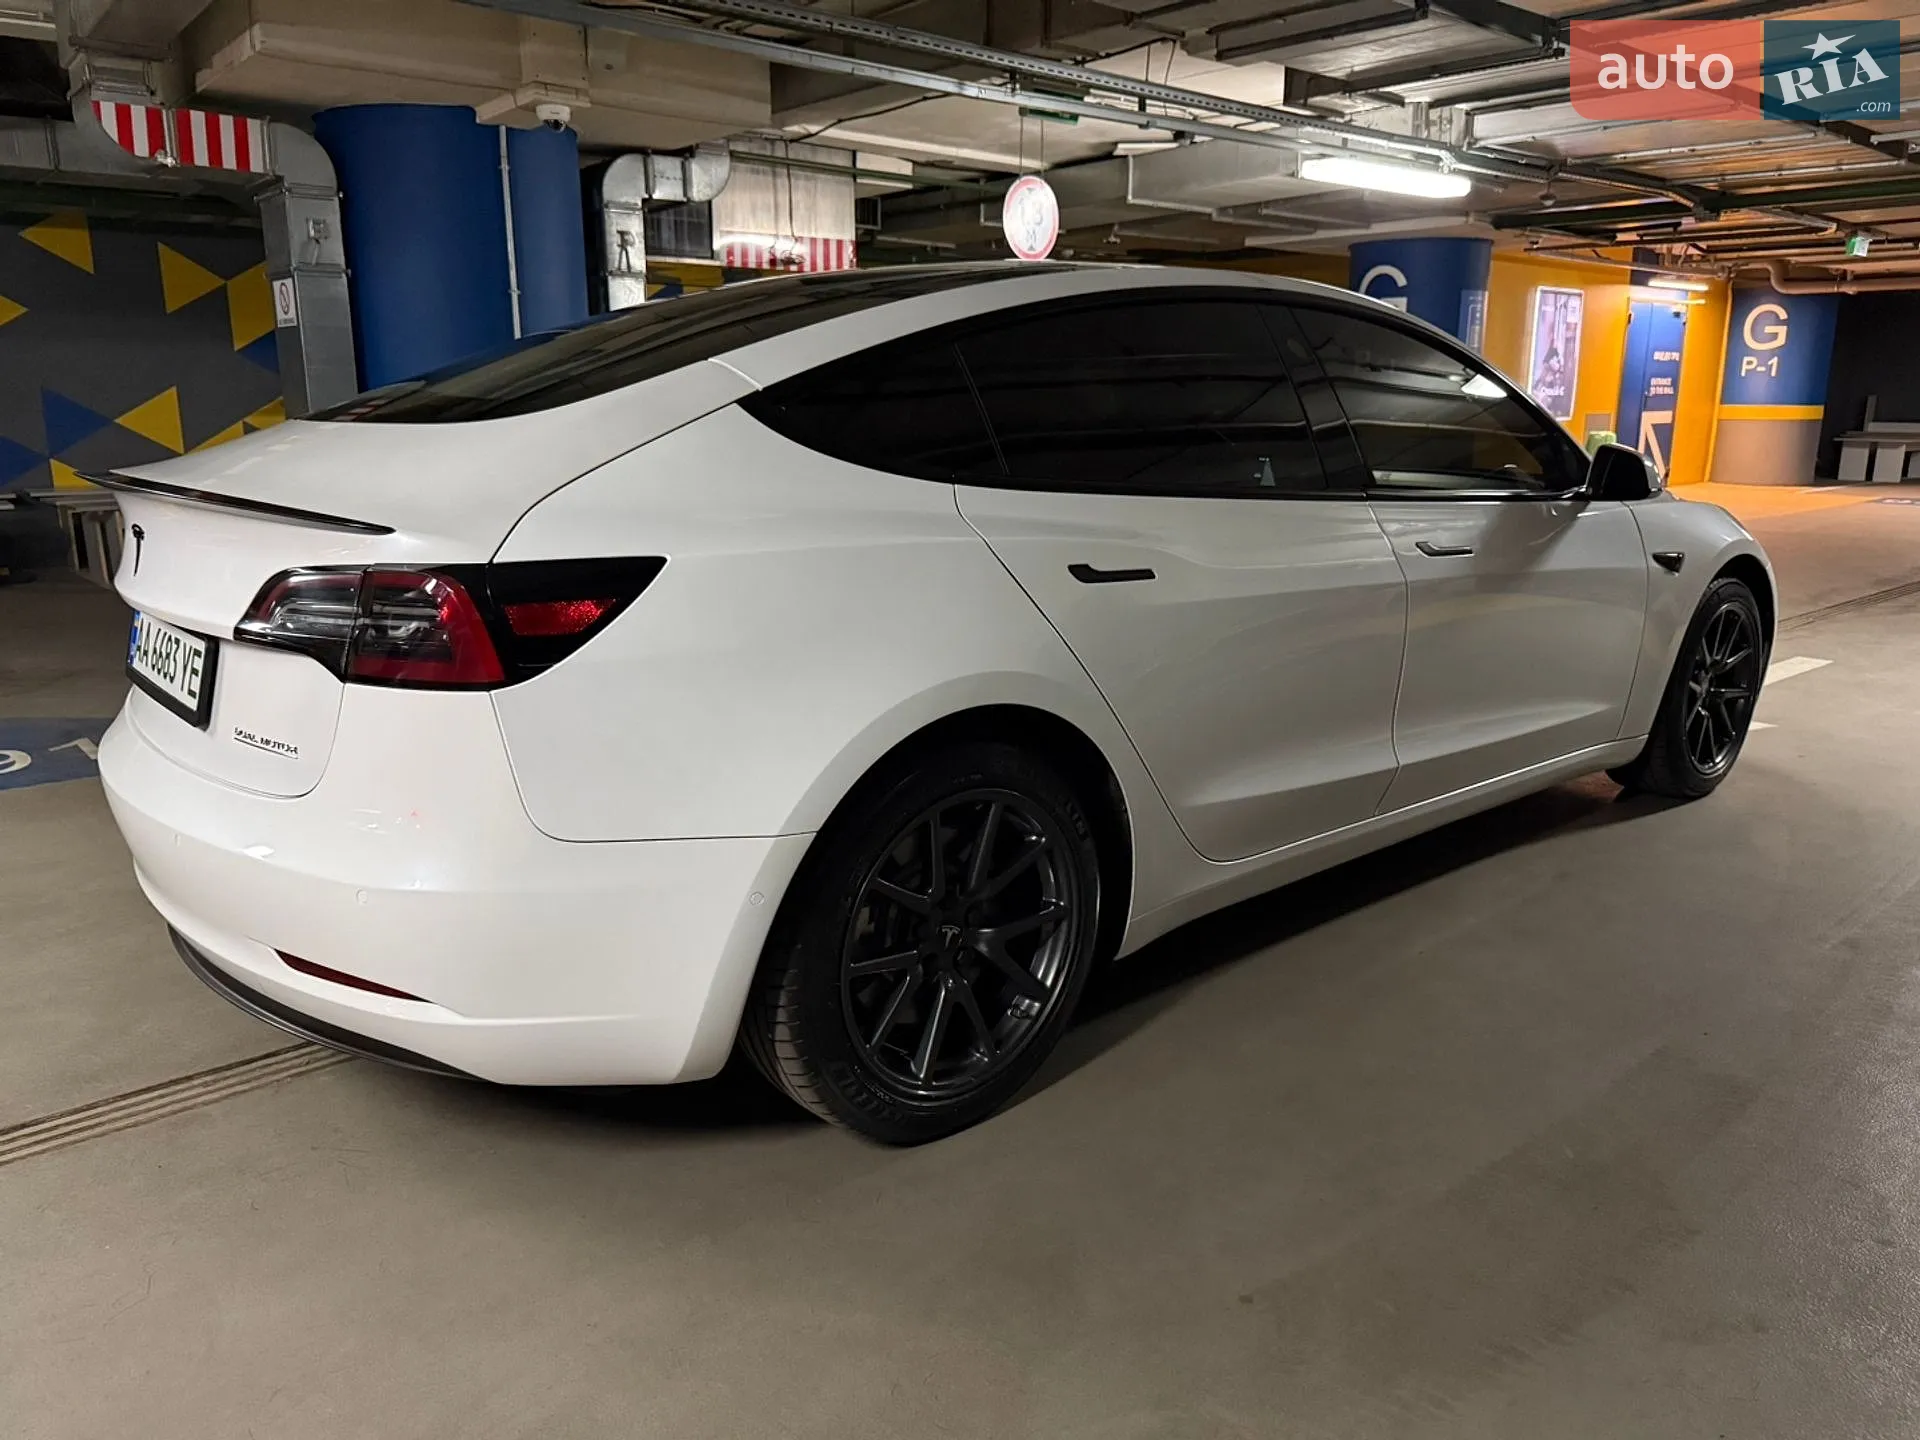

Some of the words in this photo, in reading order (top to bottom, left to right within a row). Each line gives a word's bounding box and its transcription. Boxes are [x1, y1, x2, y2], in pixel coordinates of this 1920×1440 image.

[1743, 303, 1789, 351] G
[1740, 355, 1779, 378] P-1
[136, 617, 151, 667] AA
[150, 627, 181, 684] 6683
[180, 641, 202, 699] YE
